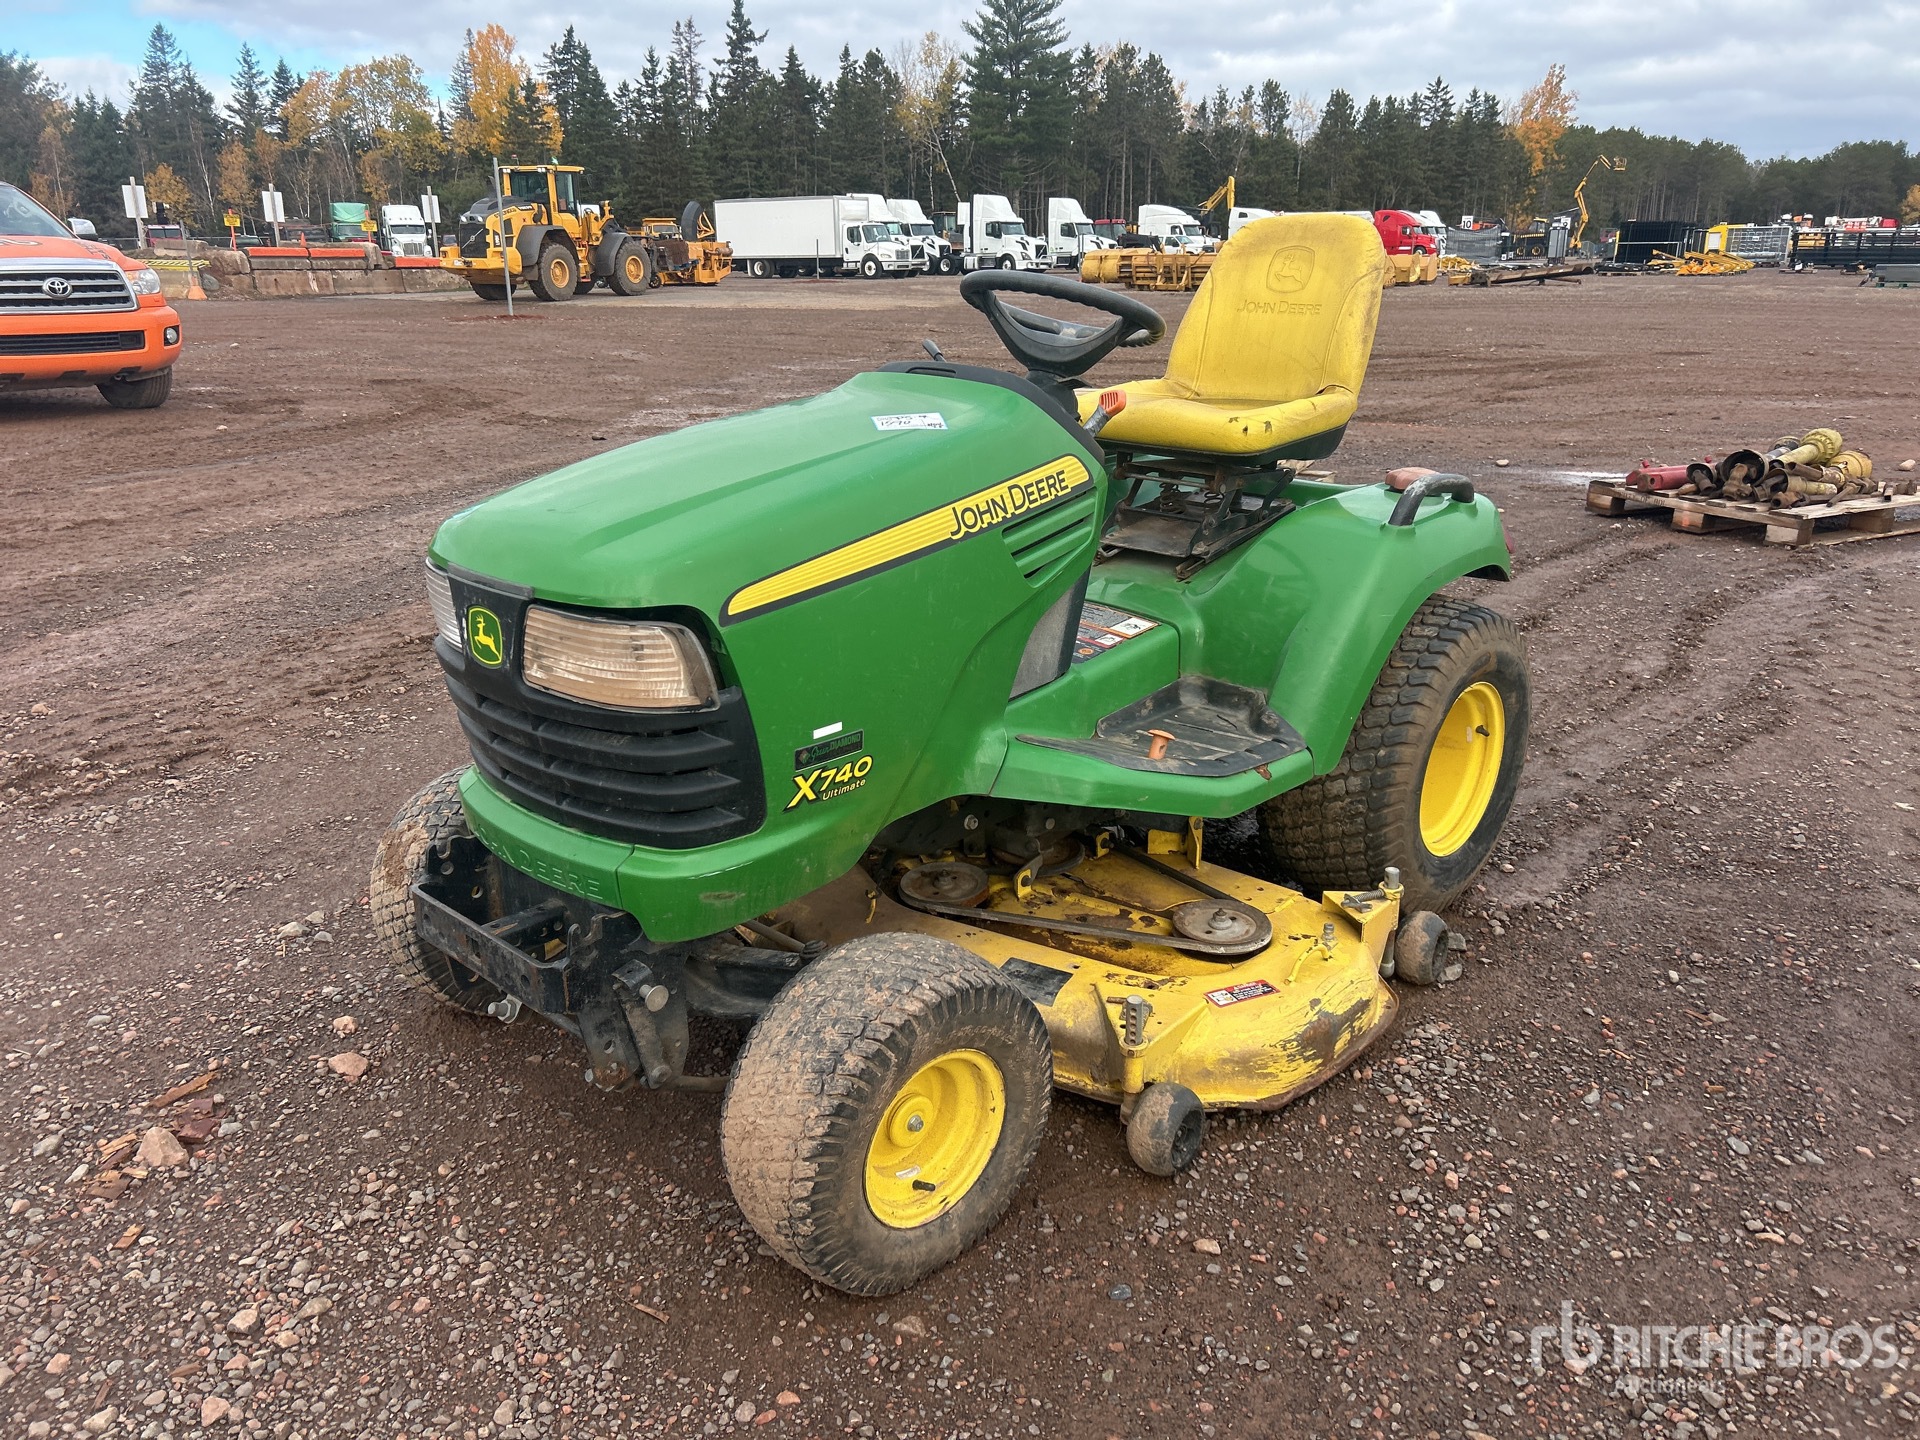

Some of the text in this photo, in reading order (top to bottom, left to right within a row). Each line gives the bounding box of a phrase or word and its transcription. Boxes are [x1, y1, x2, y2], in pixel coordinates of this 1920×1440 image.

[1462, 220, 1472, 229] 10
[1237, 299, 1322, 316] JOHN DEERE
[950, 470, 1069, 537] JOHN DEERE
[785, 755, 873, 811] X740
[822, 779, 866, 801] Ultimate
[519, 849, 604, 900] DEERE
